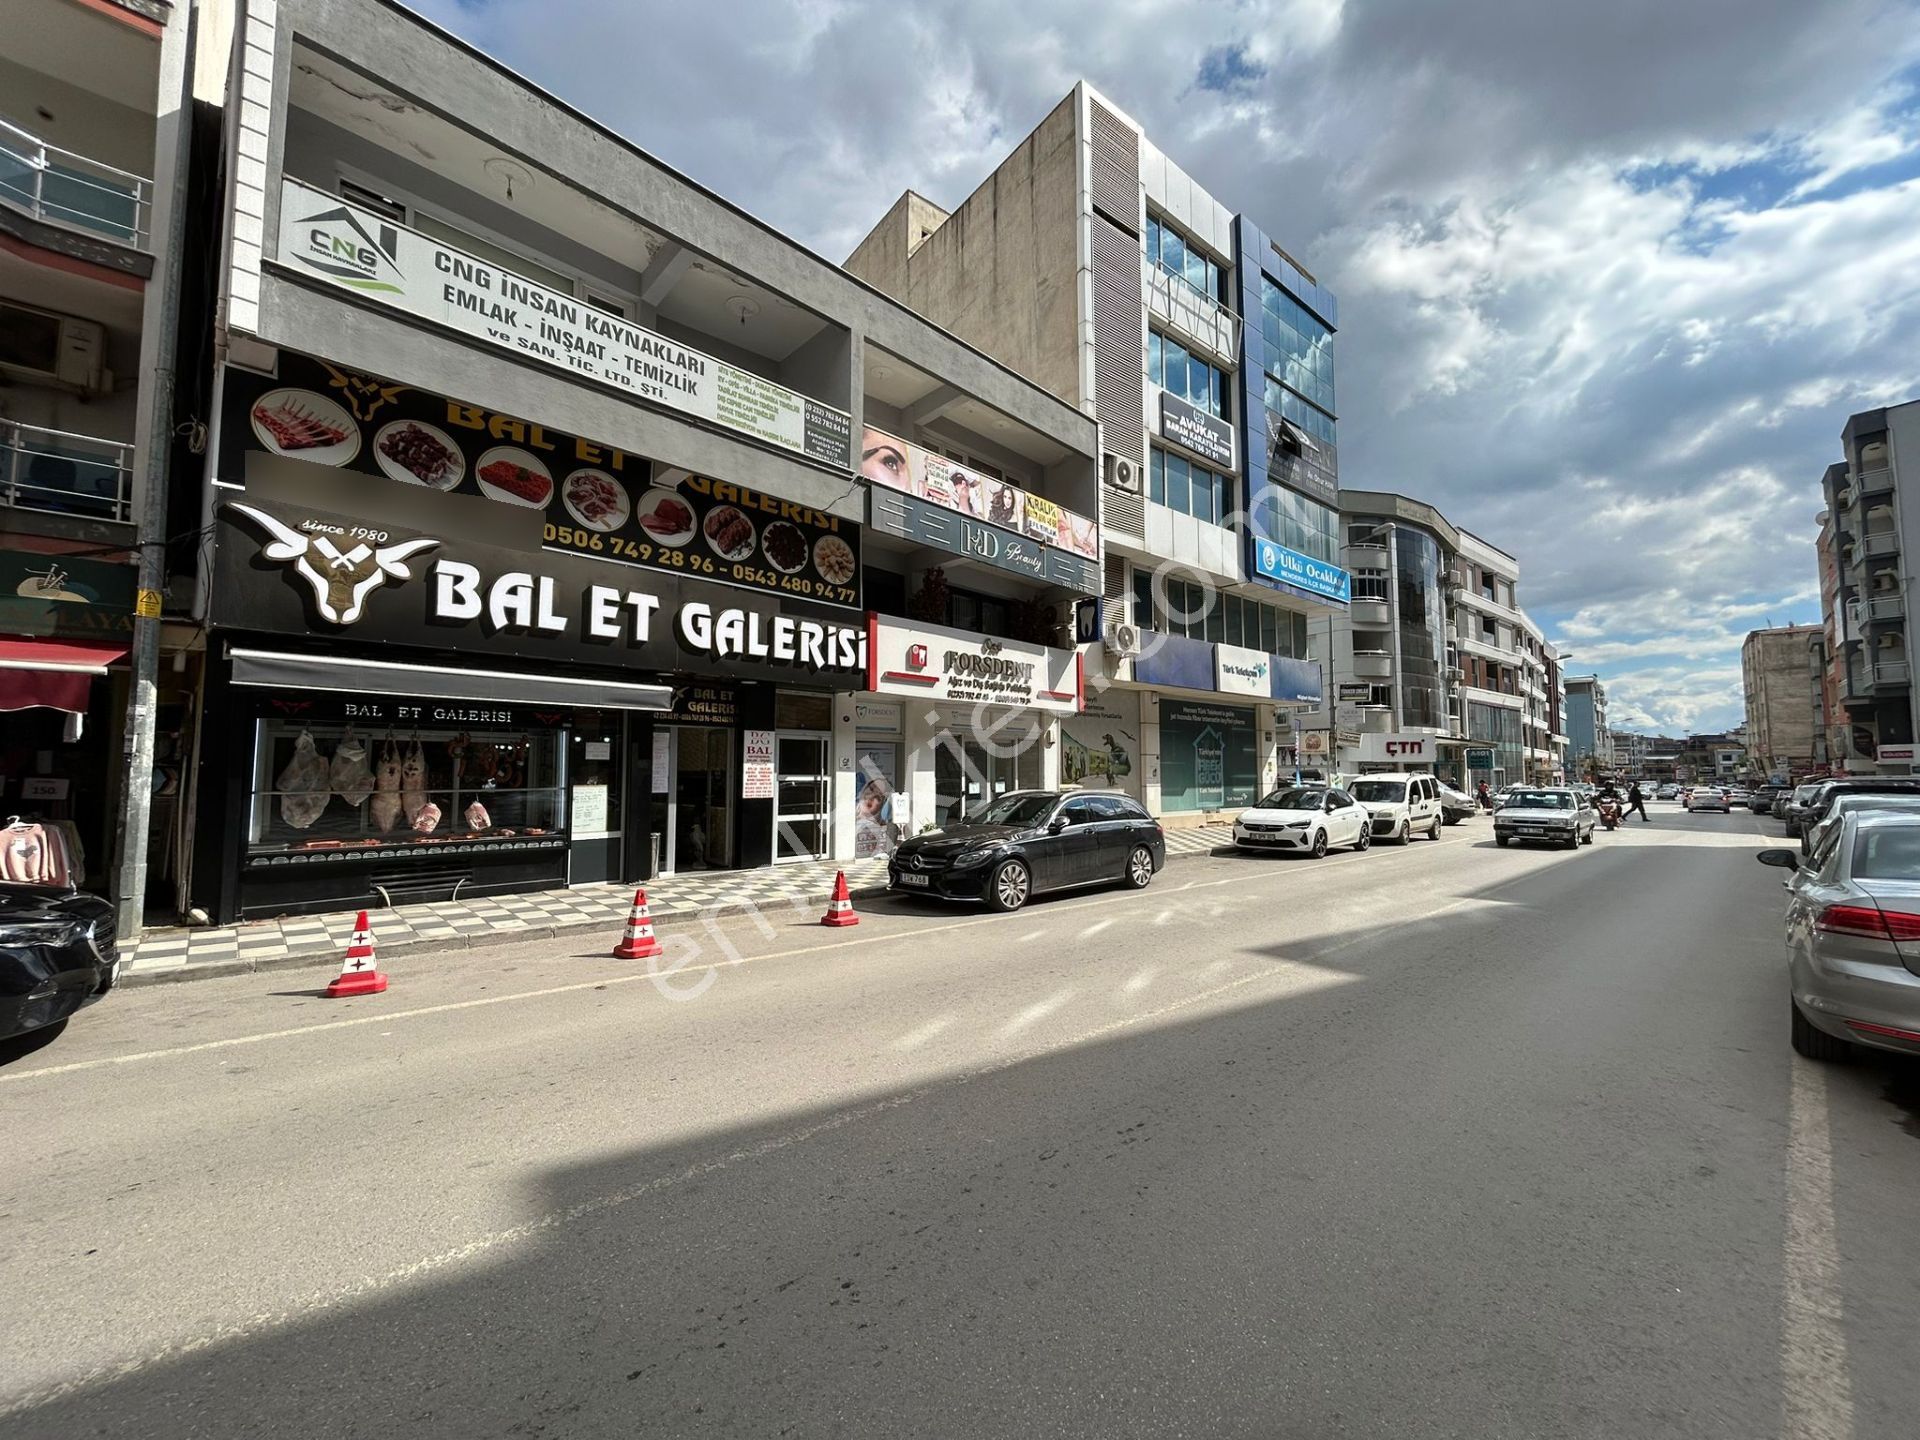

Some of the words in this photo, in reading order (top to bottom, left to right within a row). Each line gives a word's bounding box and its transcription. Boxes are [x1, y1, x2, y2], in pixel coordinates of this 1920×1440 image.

[311, 229, 377, 267] CNG
[434, 251, 491, 290] CNG
[501, 273, 577, 324] İNSAN
[585, 313, 705, 376] KAYNAKLARI
[443, 284, 518, 327] EMLAK
[539, 318, 606, 361] İNŞAAT
[624, 355, 698, 396] TEMİZLİK
[486, 327, 511, 342] ve
[604, 368, 635, 388] LTD.
[446, 402, 556, 451] BAL
[1179, 416, 1220, 442] AVUKAT
[302, 519, 345, 535] since
[349, 526, 388, 542] 1980
[543, 523, 603, 551] 0506
[610, 536, 652, 561] 749
[657, 549, 685, 567] 28
[689, 554, 714, 573] 96
[732, 564, 778, 587] 0543
[781, 576, 812, 594] 480
[815, 582, 834, 599] 94
[837, 586, 856, 603] 77
[1005, 541, 1042, 573] Beauty
[434, 558, 568, 631] BAL
[590, 584, 660, 643] ET
[947, 650, 1035, 682] FORSDENT
[1222, 664, 1235, 674] Türk
[687, 701, 736, 715] GALERİS
[694, 688, 717, 700] BAL
[720, 690, 735, 701] ET
[346, 704, 382, 717] BAL
[398, 706, 421, 718] ET
[746, 746, 773, 755] BAL
